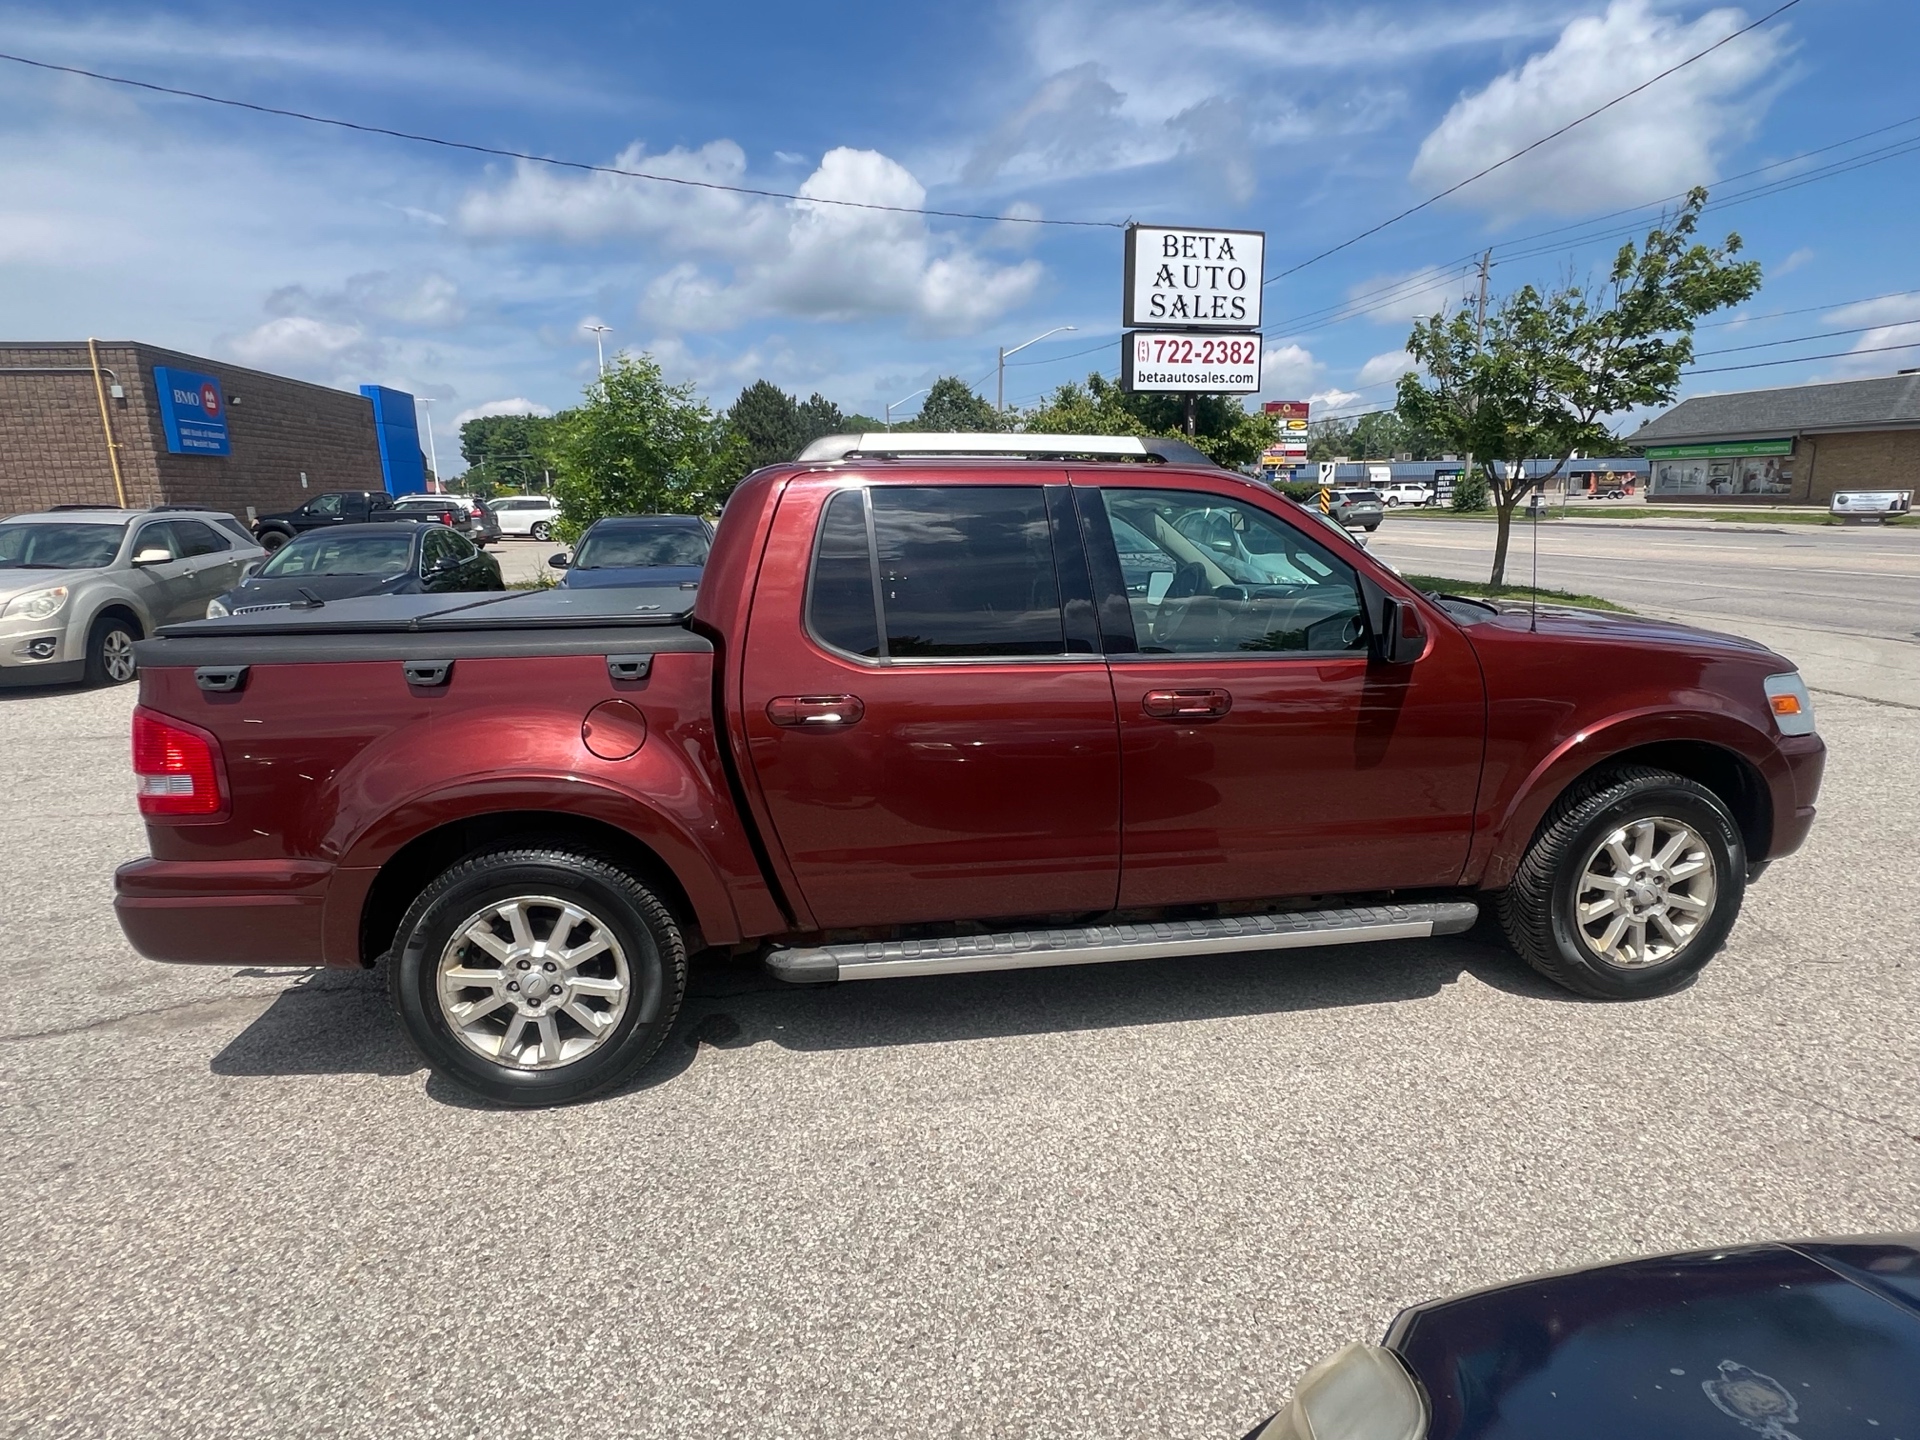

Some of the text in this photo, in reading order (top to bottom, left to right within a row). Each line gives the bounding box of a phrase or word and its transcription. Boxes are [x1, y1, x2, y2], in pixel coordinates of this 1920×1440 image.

[1162, 234, 1236, 260] BETA
[1152, 264, 1246, 290] AUTO
[1149, 294, 1246, 319] SALES
[1153, 340, 1255, 364] 722-2382
[1138, 371, 1254, 384] betaautosales.com
[173, 389, 200, 406] BMO
